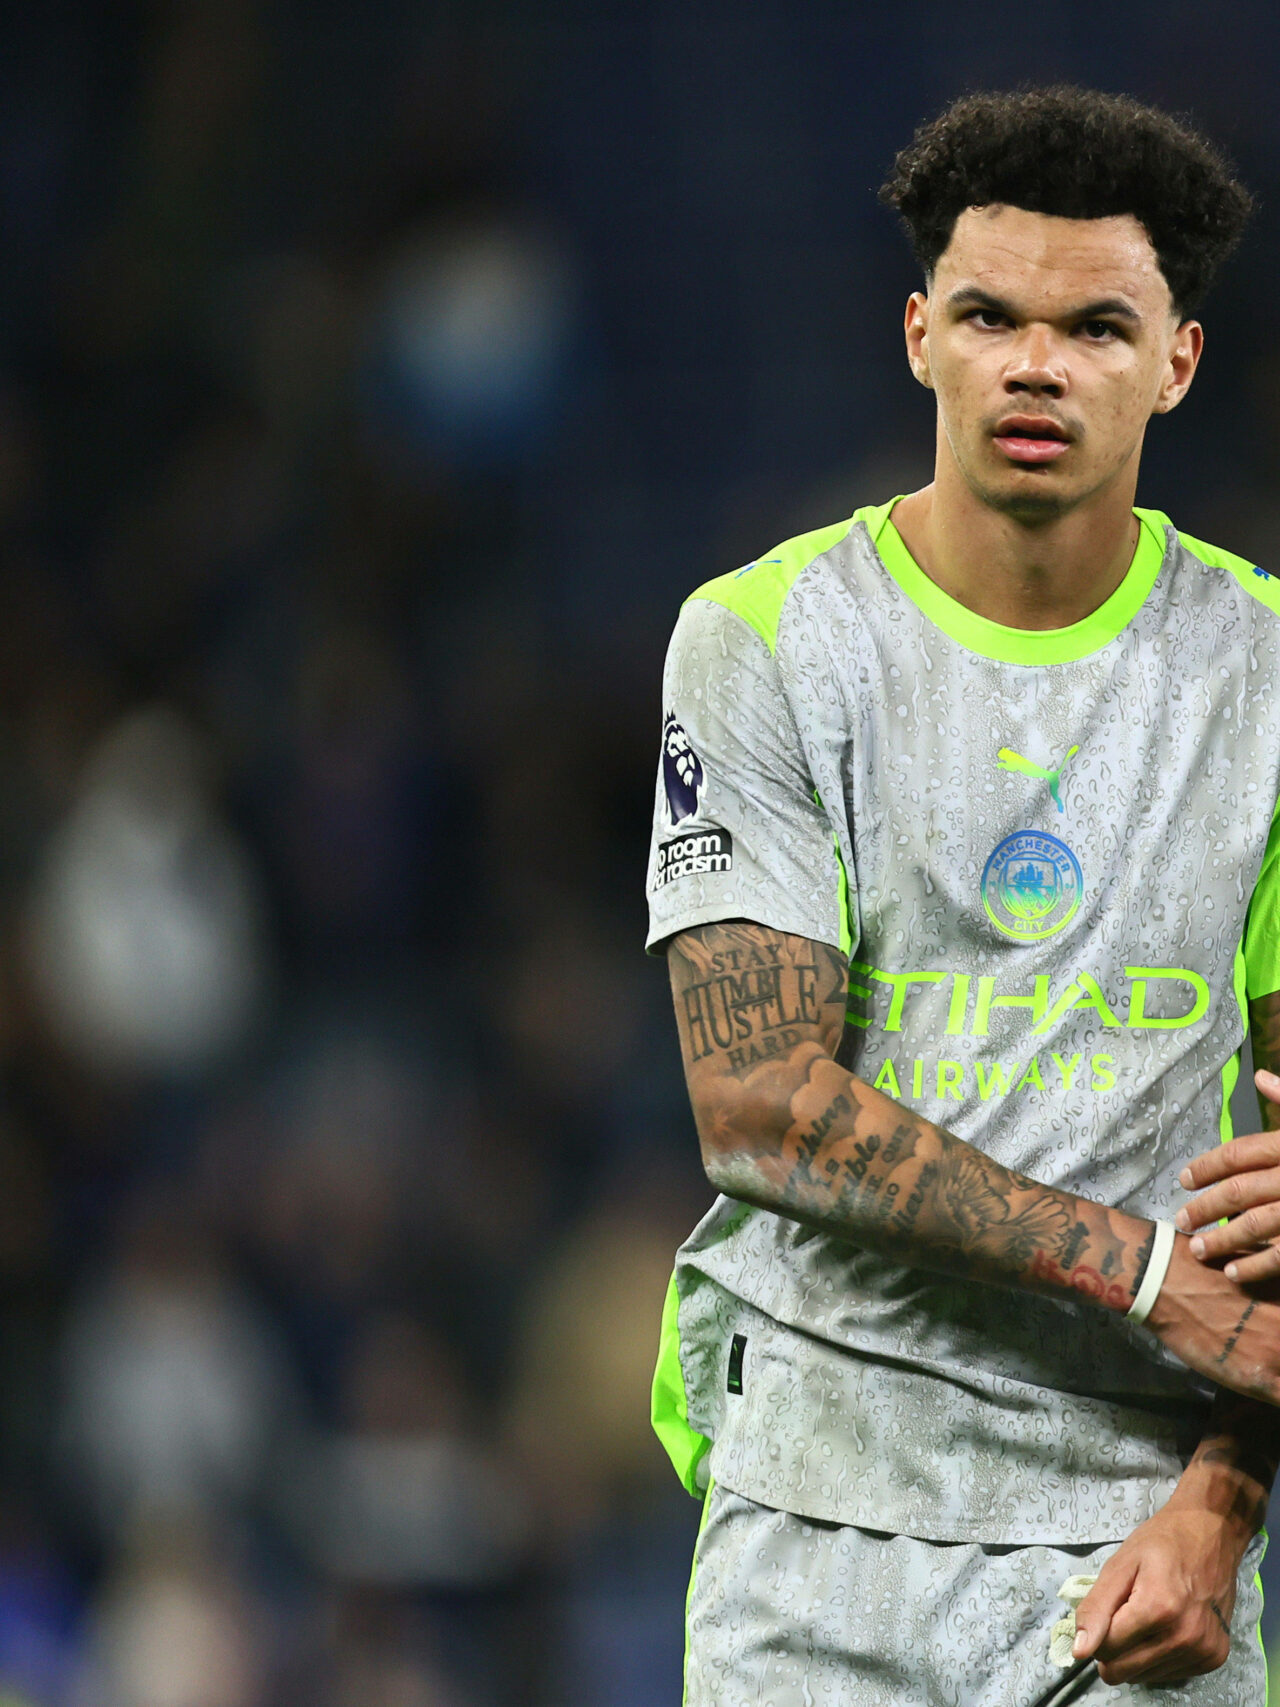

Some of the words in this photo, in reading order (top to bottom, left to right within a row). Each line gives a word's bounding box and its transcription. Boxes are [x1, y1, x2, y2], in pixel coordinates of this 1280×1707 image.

[667, 835, 722, 863] room
[992, 838, 1071, 873] MANCHESTER
[666, 853, 732, 882] racism
[1013, 920, 1044, 932] CITY
[711, 943, 781, 974] STAY
[726, 1029, 803, 1071] HARD
[872, 1053, 1117, 1102] AIRWAYS
